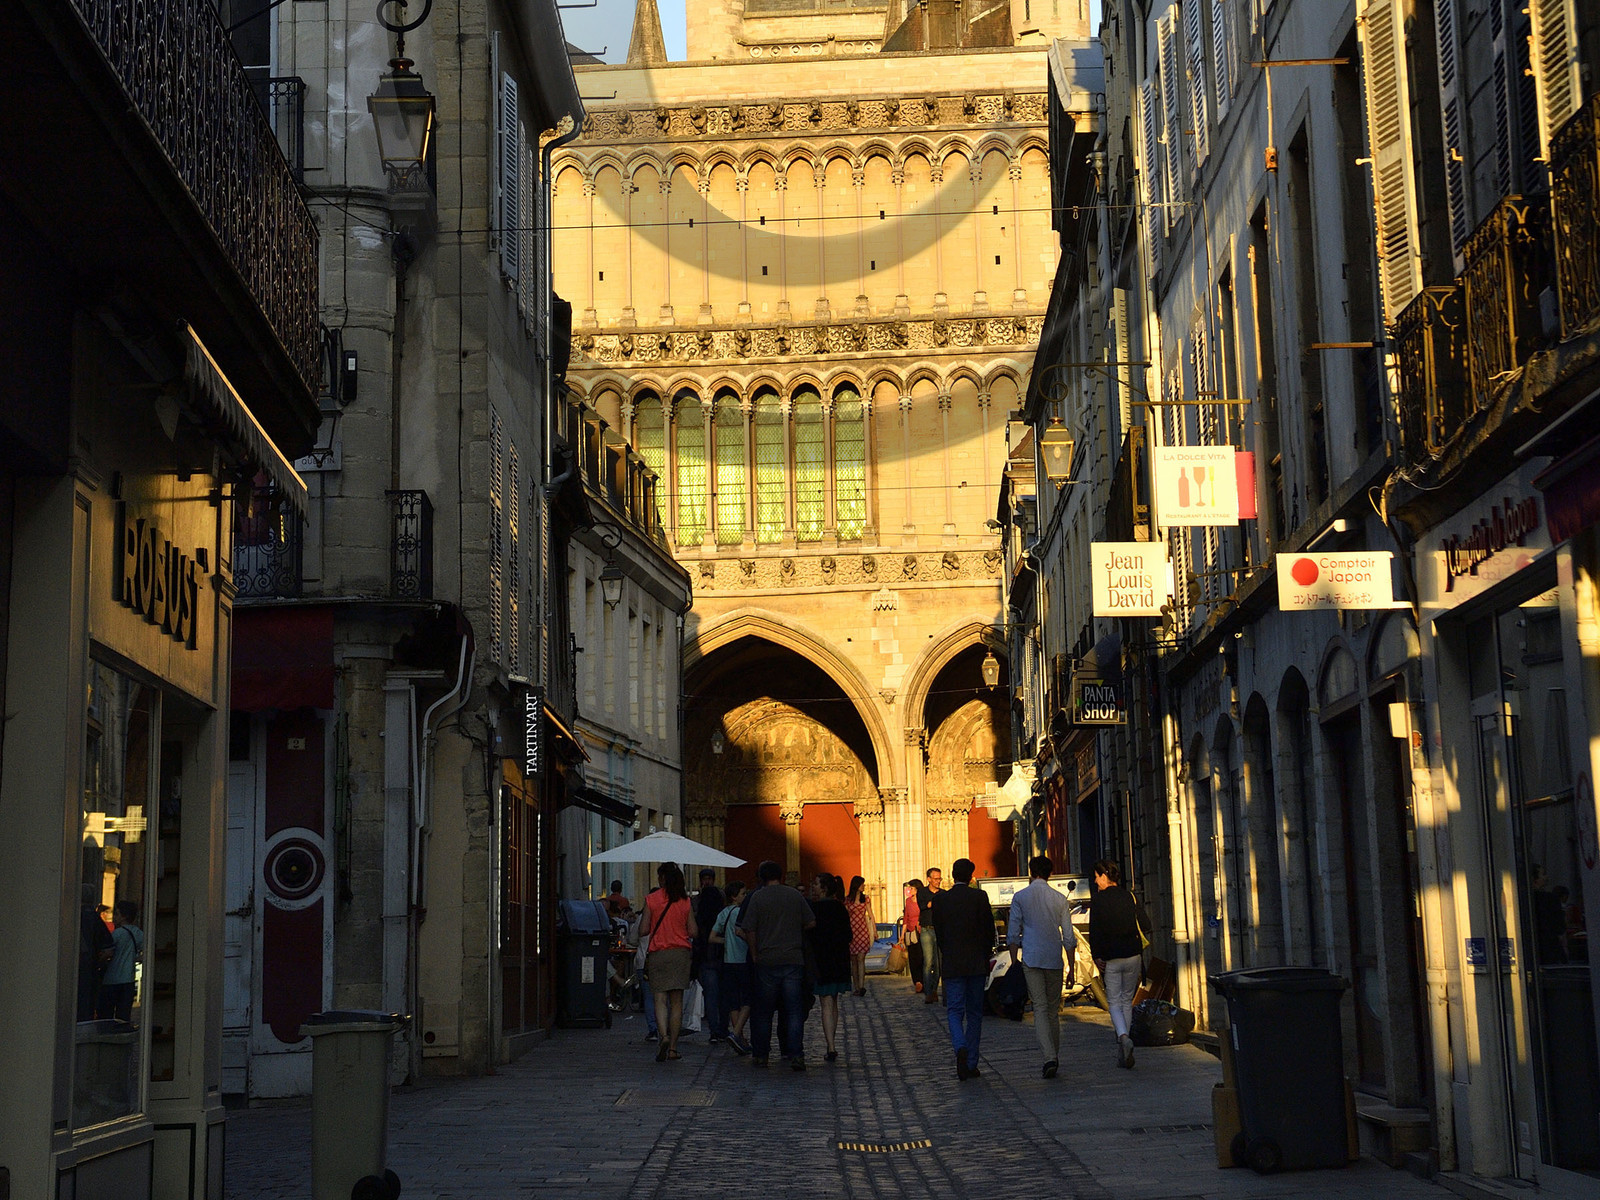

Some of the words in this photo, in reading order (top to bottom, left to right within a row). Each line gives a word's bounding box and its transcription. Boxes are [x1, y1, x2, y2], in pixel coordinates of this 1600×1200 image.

[1177, 453, 1206, 461] DOLCE
[1105, 551, 1144, 570] Jean
[1319, 557, 1375, 570] Comptoir
[112, 500, 209, 651] ROBUST
[1107, 570, 1153, 589] Louis
[1328, 570, 1372, 584] Japon
[1108, 589, 1154, 608] David
[1084, 686, 1116, 702] PANTA
[1084, 703, 1116, 720] SHOP
[525, 693, 538, 776] TARTIN'ART
